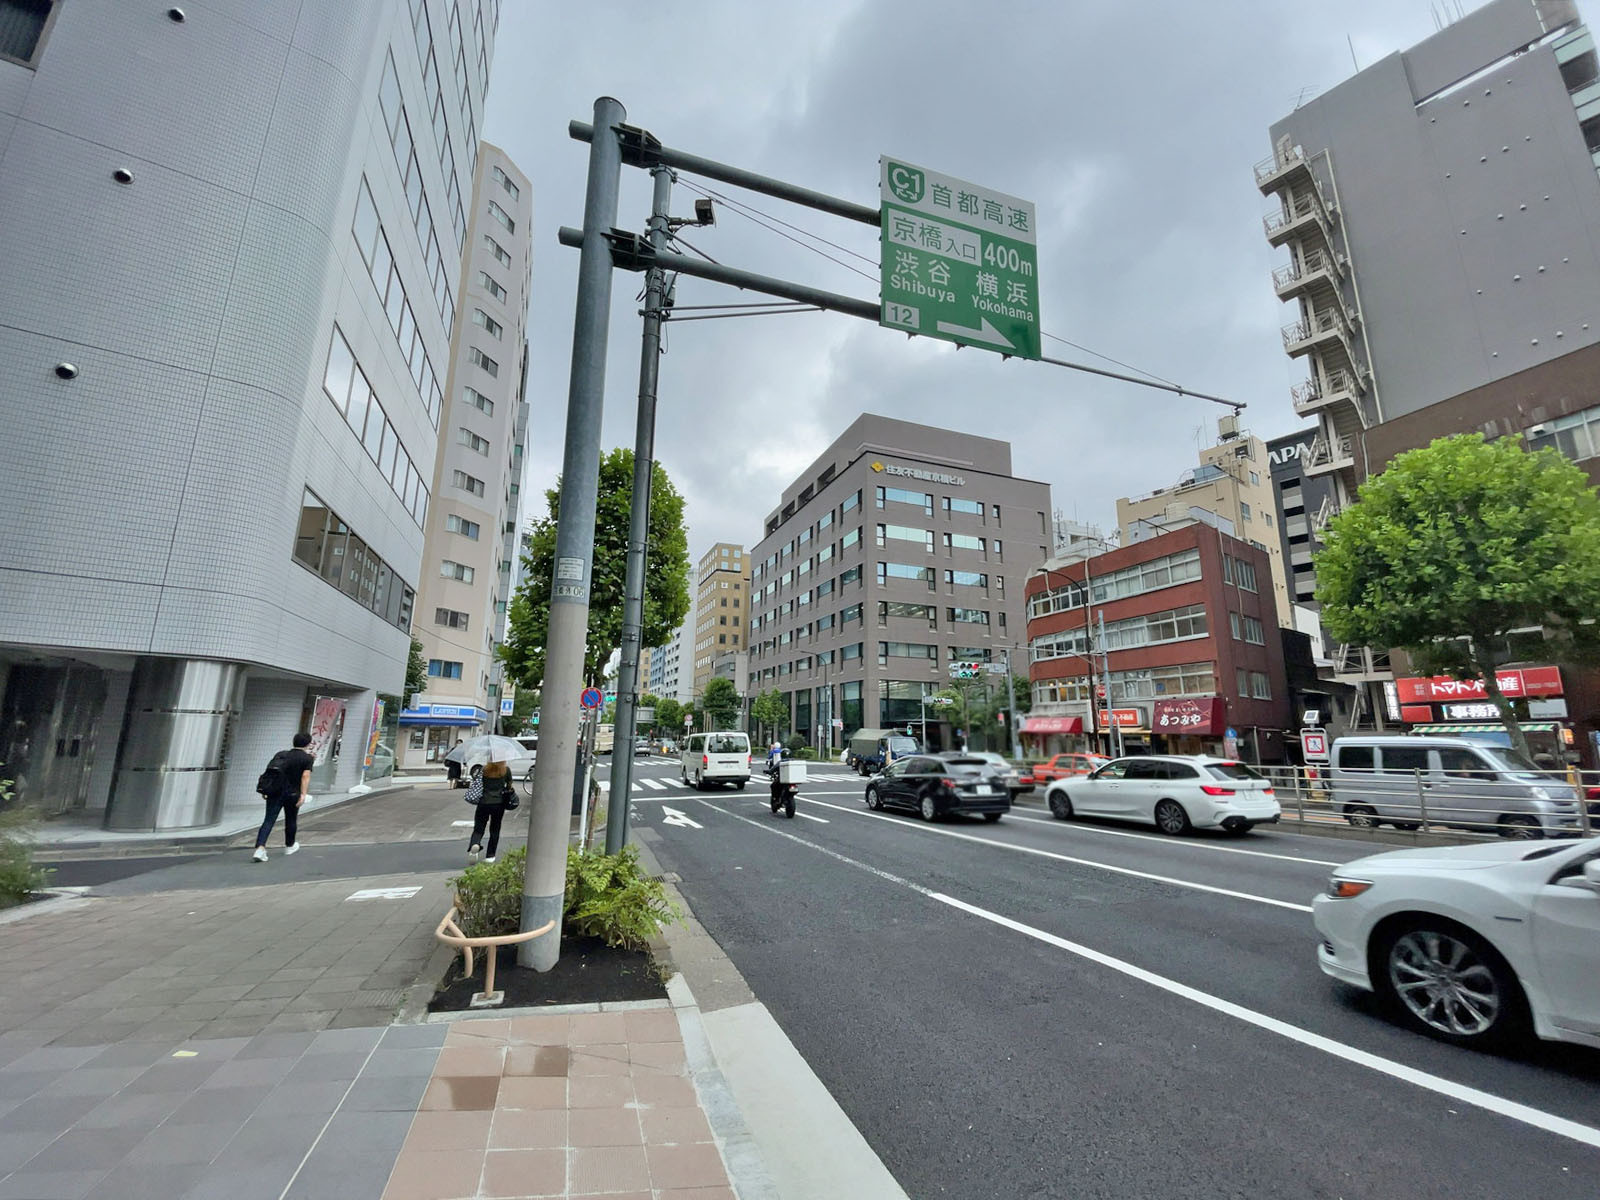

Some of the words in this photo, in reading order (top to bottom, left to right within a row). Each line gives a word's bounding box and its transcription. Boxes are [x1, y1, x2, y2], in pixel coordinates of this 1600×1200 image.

[892, 167, 920, 194] C1
[931, 182, 1029, 233] 首都高速
[893, 215, 977, 260] 京橋入口
[895, 249, 951, 287] 渋谷
[984, 242, 1032, 277] 400m
[890, 274, 956, 303] Shibuya
[975, 270, 1029, 306] 横浜
[891, 306, 913, 325] 12
[972, 295, 1034, 323] Yokohama
[1160, 714, 1201, 726] あつみや
